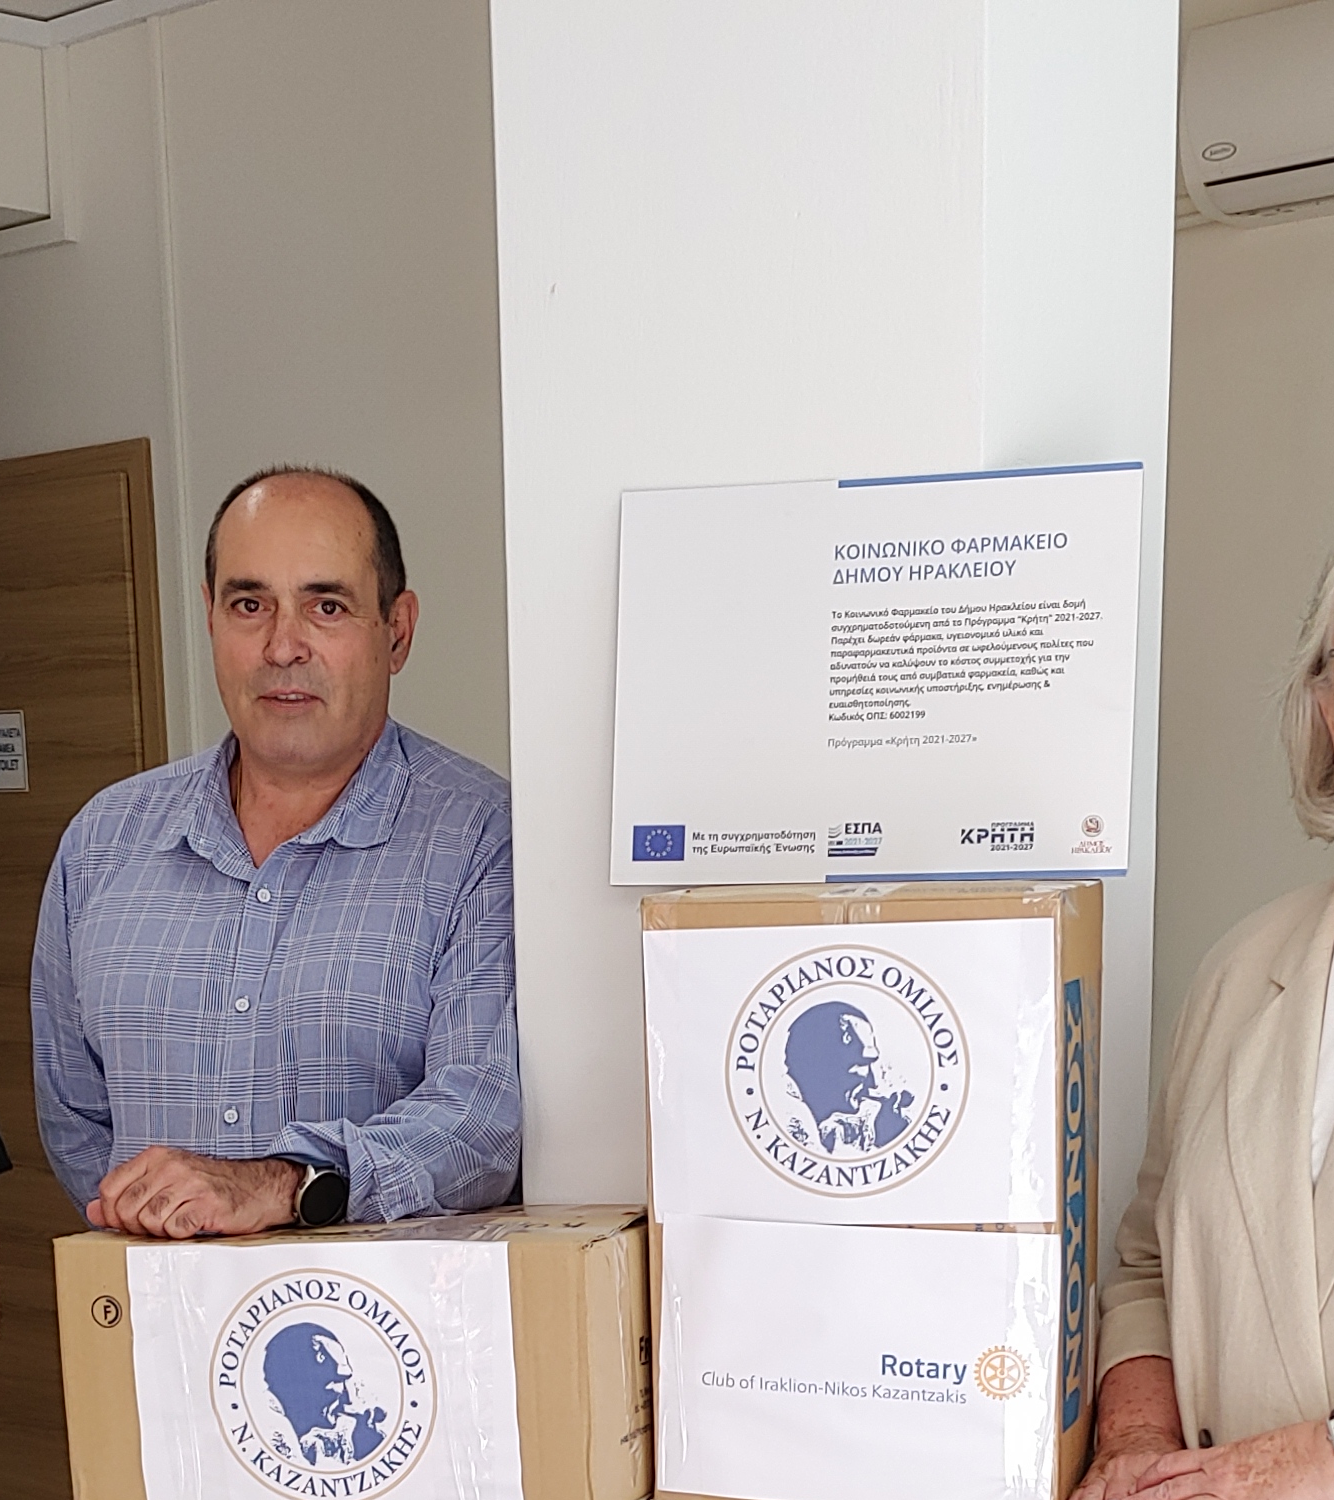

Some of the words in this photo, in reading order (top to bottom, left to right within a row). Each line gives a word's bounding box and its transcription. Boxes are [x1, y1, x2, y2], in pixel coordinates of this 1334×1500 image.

[834, 539, 945, 561] ΚΟΙΝΩΝΙΚΟ
[950, 532, 1068, 555] ΦΑΡΜΑΚΕΙΟ
[832, 565, 904, 585] ΔΗΜΟΥ
[909, 560, 1017, 581] ΗΡΑΚΛΕΙΟΥ
[832, 611, 842, 619] Το
[844, 608, 889, 619] Κοινωνικό
[891, 606, 939, 618] Φαρμακείο
[941, 606, 956, 614] του
[958, 604, 986, 615] Δήμου
[989, 601, 1036, 613] Ηρακλείου
[1038, 601, 1060, 610] είναι
[1063, 599, 1086, 610] δομή
[831, 620, 930, 633] συγχρηματοδοτούμενη
[932, 618, 950, 628] από
[952, 619, 963, 627] το
[965, 616, 1016, 627] Πρόγραμμα
[831, 636, 866, 646] Παρέχει
[867, 634, 900, 645] δωρεάν
[946, 629, 1000, 642] υγειονομικό
[1002, 628, 1027, 637] υλικό
[830, 645, 914, 658] παραφαρμακευτικά
[916, 644, 957, 655] προϊόντα
[972, 641, 1037, 653] ωφελούμενους
[1040, 639, 1074, 650] πολίτες
[1076, 639, 1094, 647] που
[830, 659, 877, 670] αδυνατούν
[892, 659, 936, 669] καλύψουν
[950, 656, 981, 666] κόστος
[983, 654, 1036, 666] συμμετοχής
[1038, 654, 1052, 665] για
[1055, 654, 1070, 663] την
[830, 674, 876, 685] προμήθειά
[878, 674, 898, 683] τους
[900, 672, 917, 680] από
[919, 669, 966, 681] συμβατικά
[1020, 667, 1049, 676] καθώς
[1051, 667, 1065, 675] και
[829, 687, 874, 697] υπηρεσίες
[876, 684, 925, 695] κοινωνικής
[987, 680, 1042, 691] ενημέρωσης
[1044, 680, 1051, 688] &
[828, 712, 864, 722] Κωδικός
[867, 711, 887, 720] ΟΠΣ:
[889, 710, 926, 719] 6002199
[827, 737, 883, 749] Πρόγραμμα
[885, 735, 920, 747] «Κρήτη
[922, 733, 977, 745] 2021-2027»
[692, 832, 706, 841] Με
[708, 833, 719, 842] τη
[721, 830, 816, 842] συγχρηματοδότηση
[845, 822, 883, 835] ΕΣΠΑ
[961, 827, 1034, 844] ΚΡΗΤΗ
[692, 846, 708, 855] της
[710, 843, 771, 854] Ευρωπαϊκής
[774, 843, 815, 854] Ένωσης
[736, 956, 875, 1071] ΡΟΤΑΡΙΑΝΟΣ
[881, 967, 958, 1068] ΟΜΙΛΟΣ
[745, 1107, 770, 1139] Ν.
[765, 1105, 951, 1187] ΚΑΖΑΝΤΖΑΚΗΣ
[219, 1279, 341, 1389] ΡΟΤΑΡΙΑΝΟΣ
[348, 1290, 425, 1385] ΟΜΙΛΟΣ
[881, 1354, 968, 1385] Rotary
[701, 1371, 735, 1389] Club
[739, 1375, 756, 1390] of
[759, 1377, 867, 1398] Iraklion-Nikos
[871, 1384, 967, 1405] Kazantzakis
[231, 1422, 255, 1452] Ν.
[250, 1420, 422, 1498] ΚΑΖΑΝΤΖΑΚΗΣ
